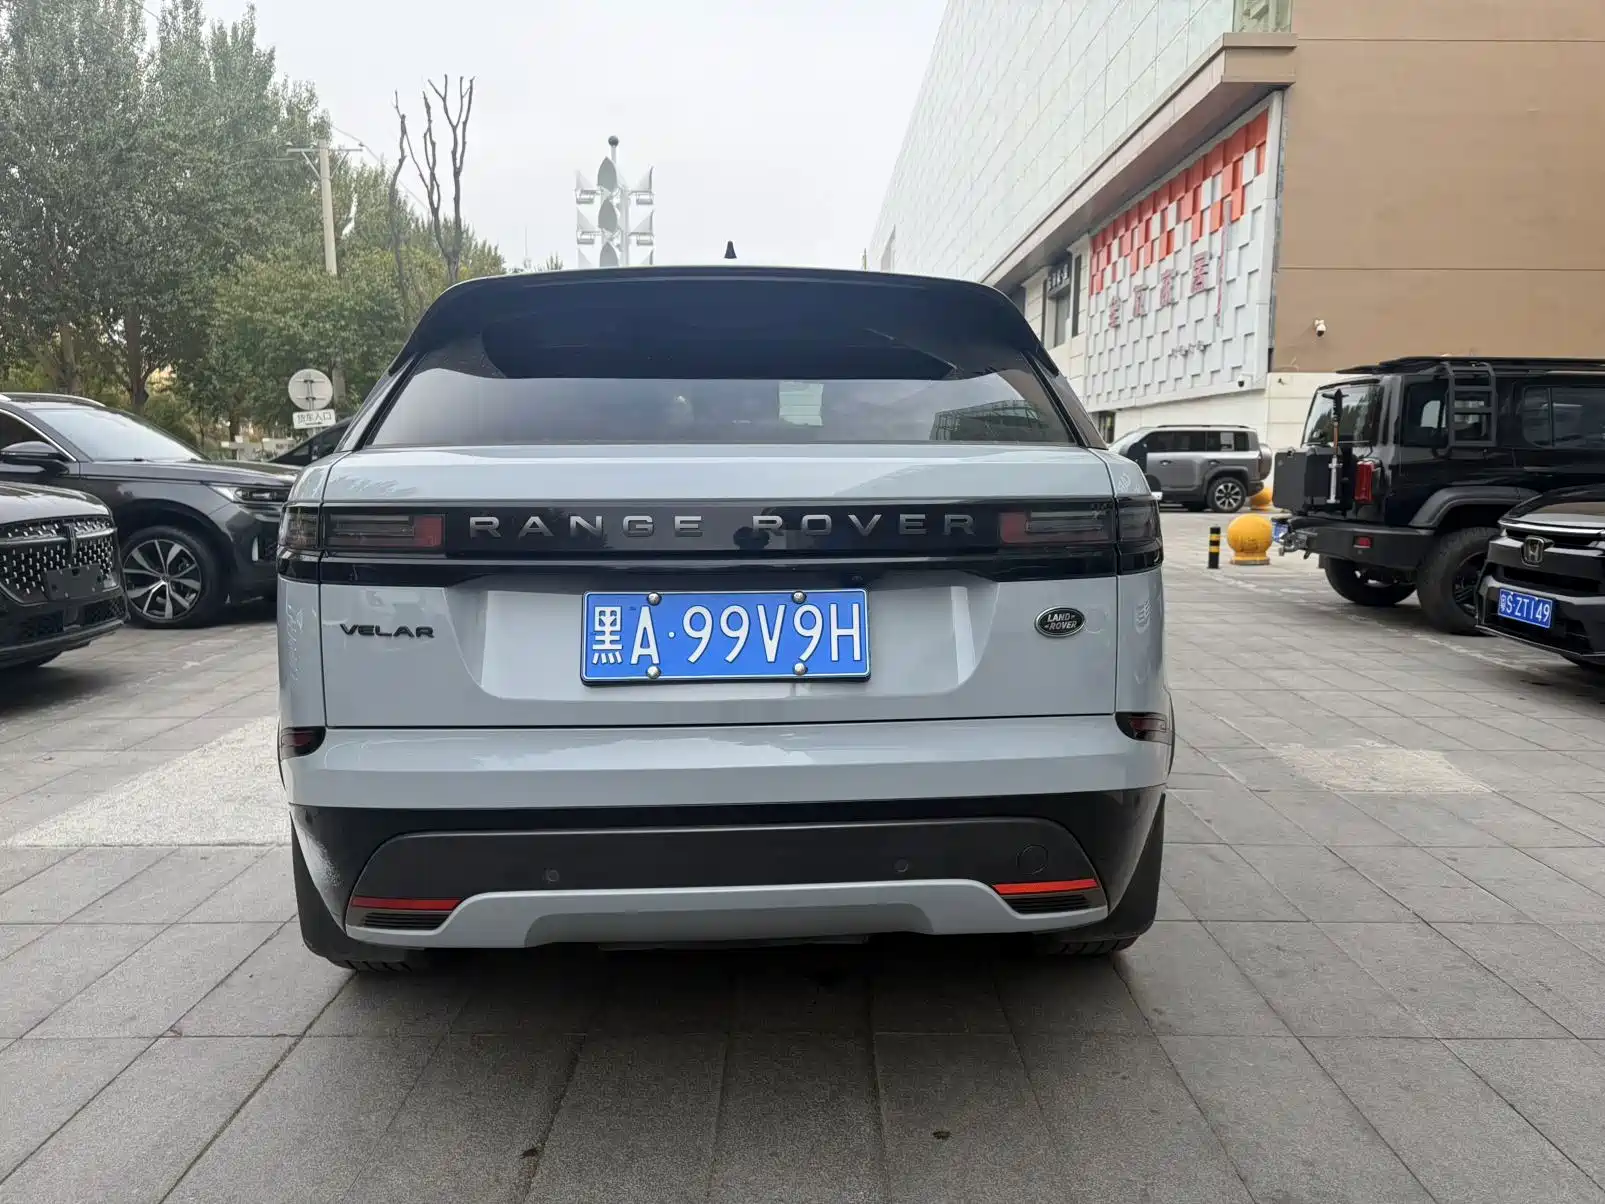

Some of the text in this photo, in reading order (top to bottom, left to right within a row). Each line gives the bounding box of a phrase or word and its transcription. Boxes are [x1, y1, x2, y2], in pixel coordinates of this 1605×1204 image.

[469, 513, 975, 538] RANGE ROVER
[1047, 613, 1071, 622] LAND
[340, 624, 435, 638] VELAR
[1049, 620, 1077, 630] ROVER
